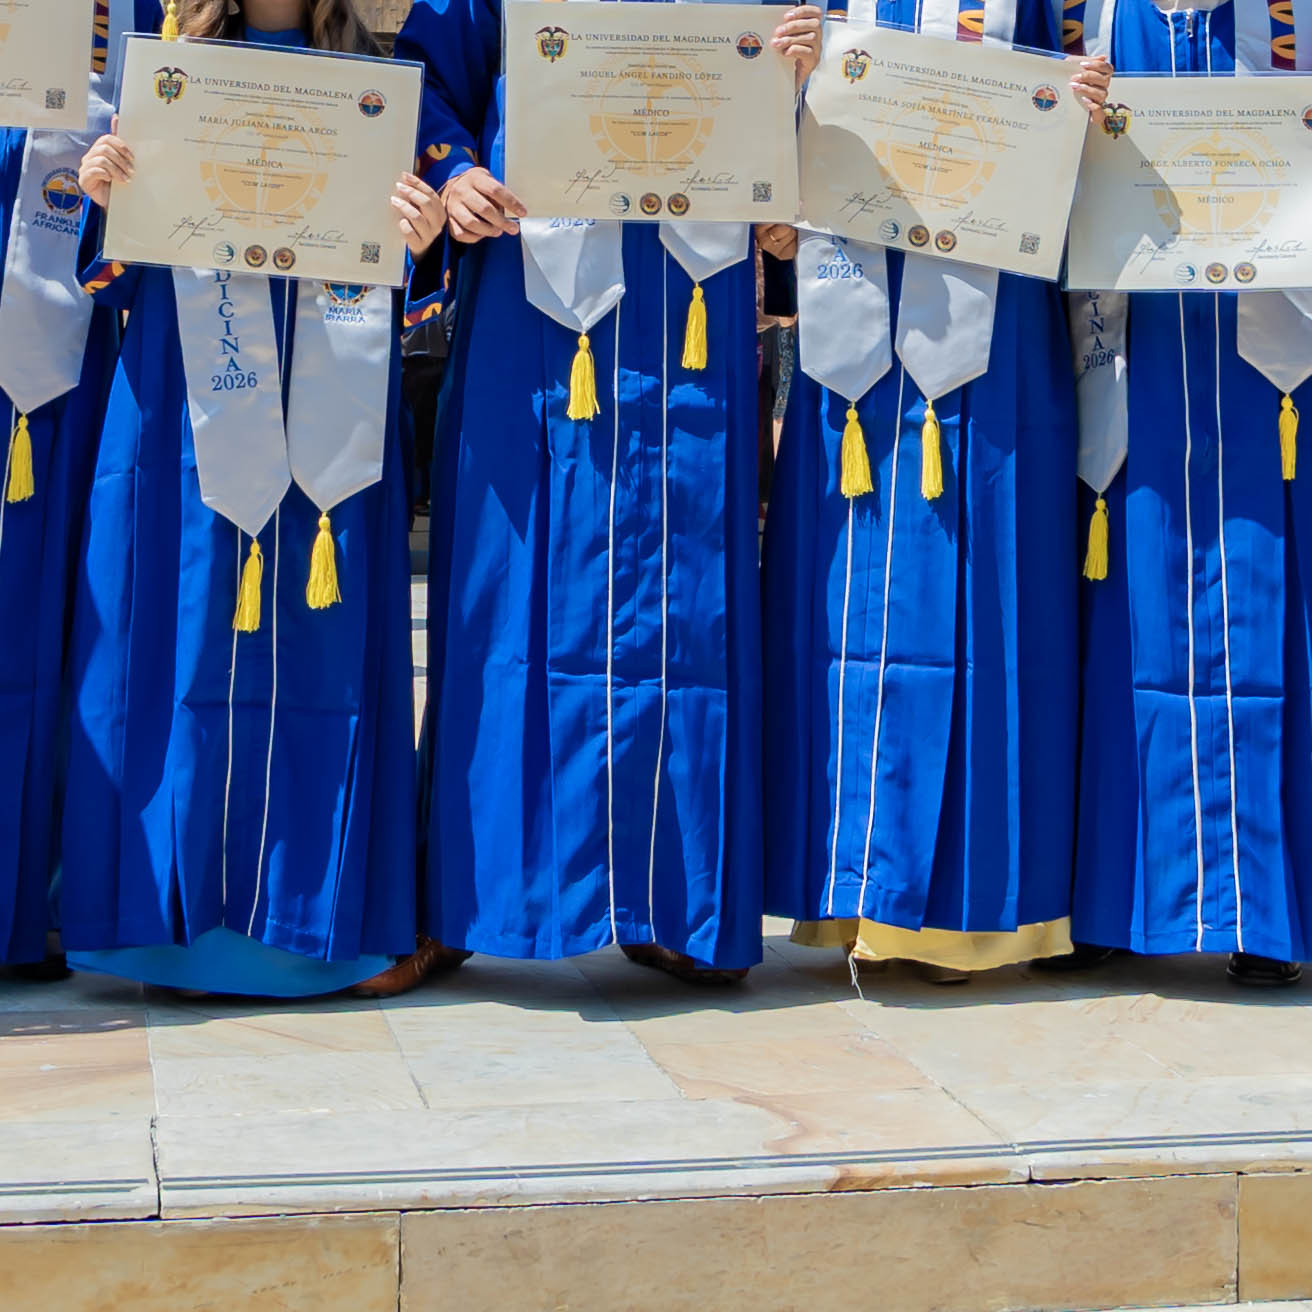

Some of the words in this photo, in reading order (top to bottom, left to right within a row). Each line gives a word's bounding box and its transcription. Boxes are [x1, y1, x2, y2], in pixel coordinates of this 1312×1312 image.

[586, 34, 650, 42] UNIVERSIDAD
[652, 35, 670, 43] DEL
[674, 35, 731, 44] MAGDALENA
[874, 59, 884, 67] LA
[888, 61, 948, 78] UNIVERSIDAD
[951, 72, 968, 81] DEL
[972, 74, 1028, 93] MAGDALENA
[190, 76, 201, 85] LA
[204, 78, 270, 92] UNIVERSIDAD
[274, 84, 291, 94] DEL
[296, 86, 353, 100] MAGDALENA
[858, 94, 898, 106] ISABELLA
[1148, 109, 1214, 118] UNIVERSIDAD
[1216, 109, 1234, 117] DEL
[1238, 109, 1296, 117] MAGDALENA
[230, 119, 269, 129] JULIANA
[272, 122, 305, 132] IBARRA
[308, 127, 338, 136] ARCOS
[1171, 160, 1212, 168] ALBERTO
[1215, 160, 1256, 168] FONSECA
[1259, 160, 1292, 168] OCHOA
[35, 211, 80, 228] FRANKLI
[32, 220, 80, 236] AFRICAN
[817, 263, 864, 279] 2026
[325, 314, 366, 324] IBARRA
[328, 306, 362, 316] MARIA
[1083, 350, 1115, 369] 2026
[211, 372, 258, 392] 2026
